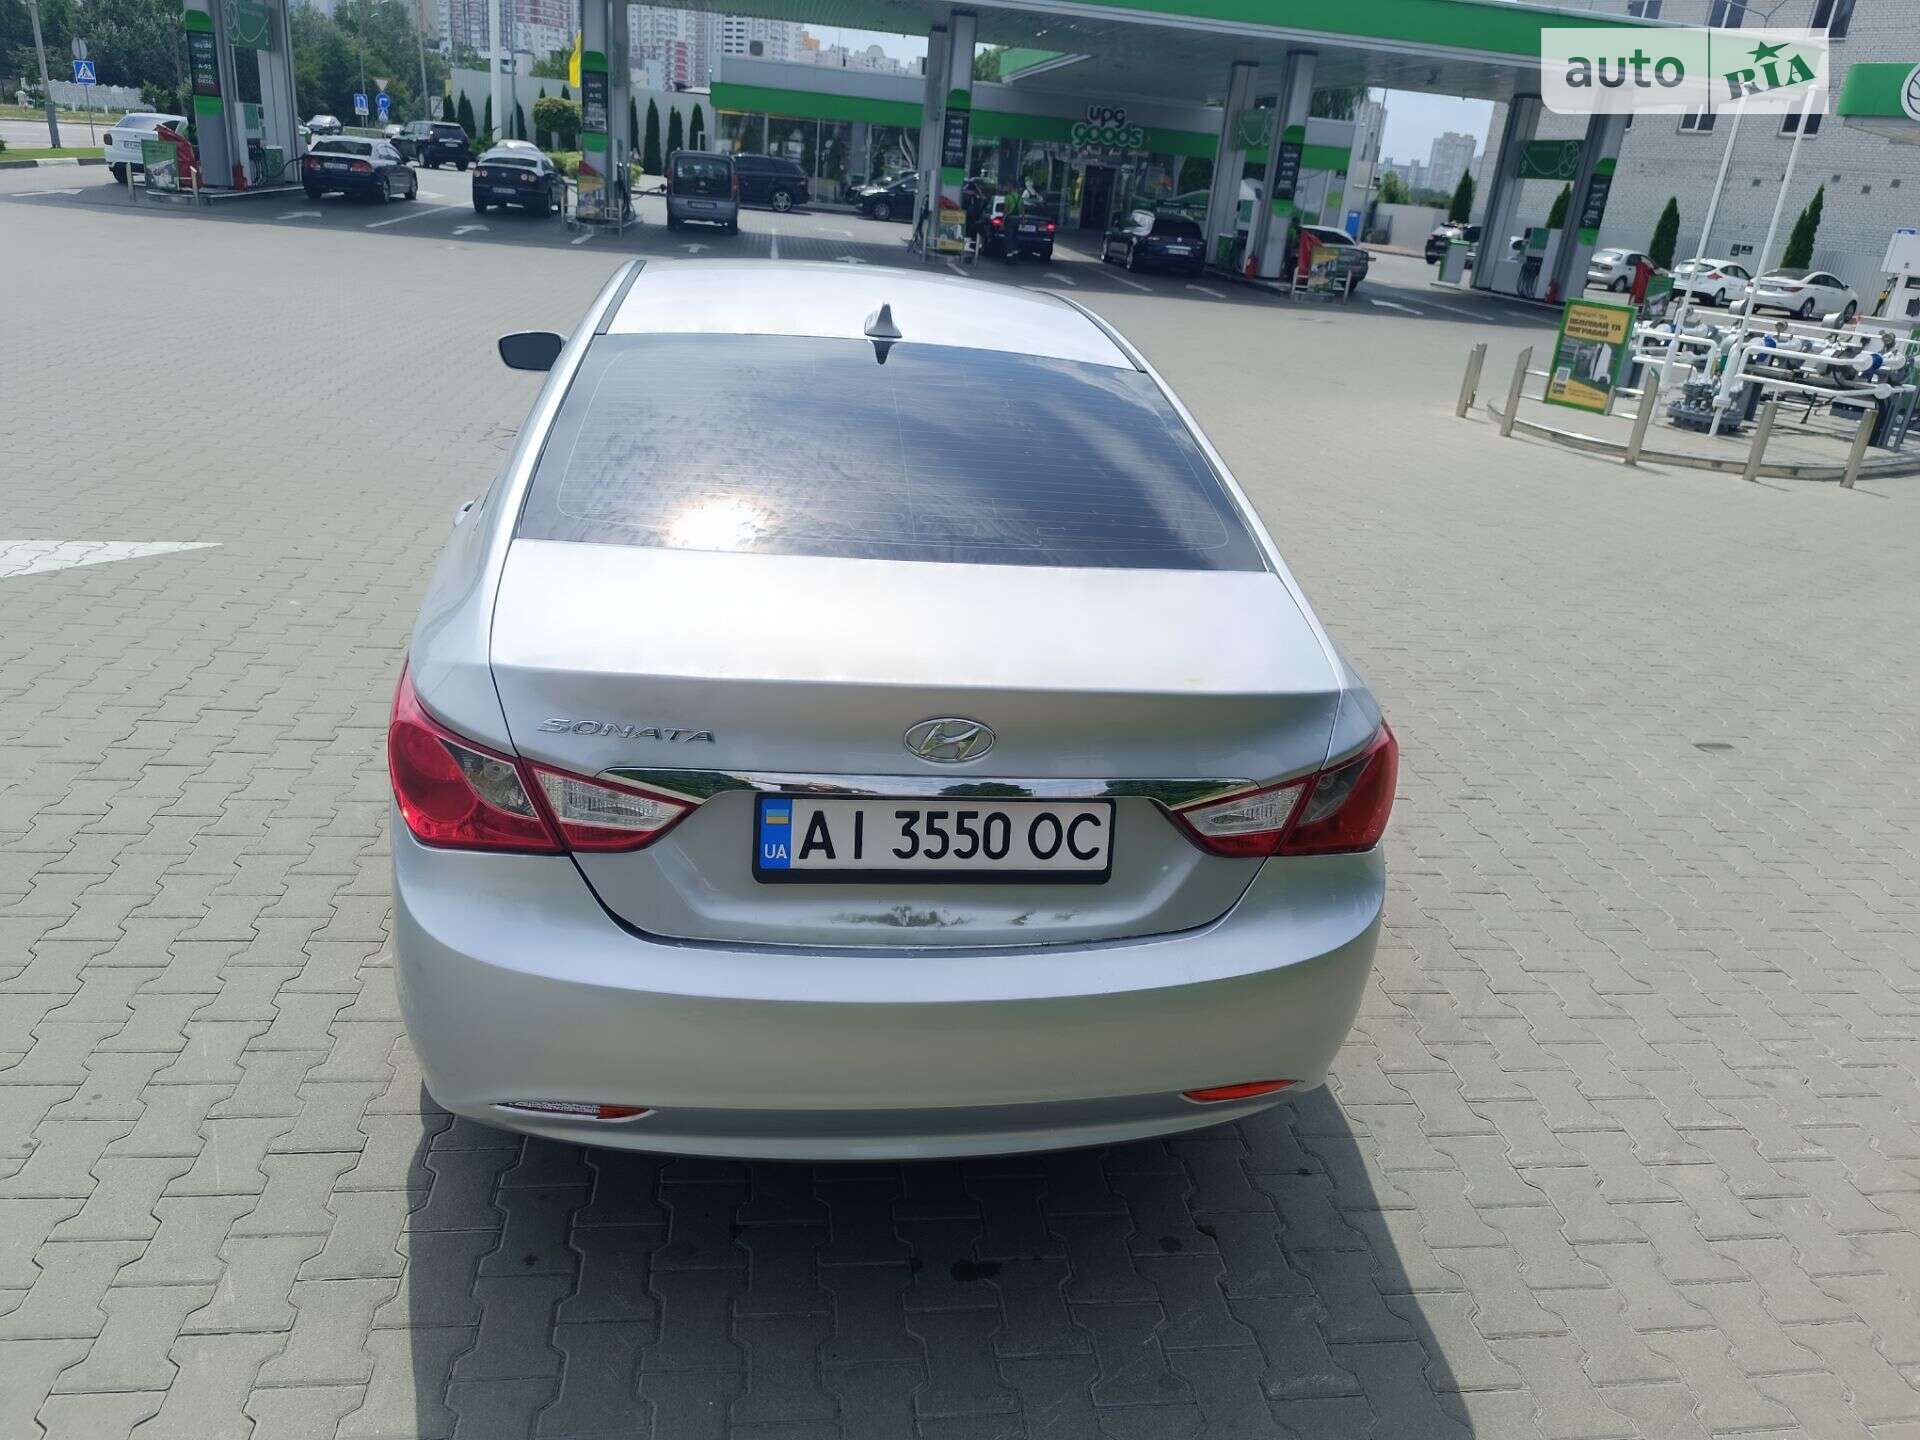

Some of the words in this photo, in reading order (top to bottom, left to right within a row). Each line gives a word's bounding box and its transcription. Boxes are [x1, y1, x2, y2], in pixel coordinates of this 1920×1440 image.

[1088, 105, 1127, 128] upg
[1072, 120, 1143, 148] goods
[537, 718, 715, 743] SONATA
[892, 810, 1011, 860] 3550
[1027, 811, 1102, 860] OC
[764, 844, 787, 859] UA
